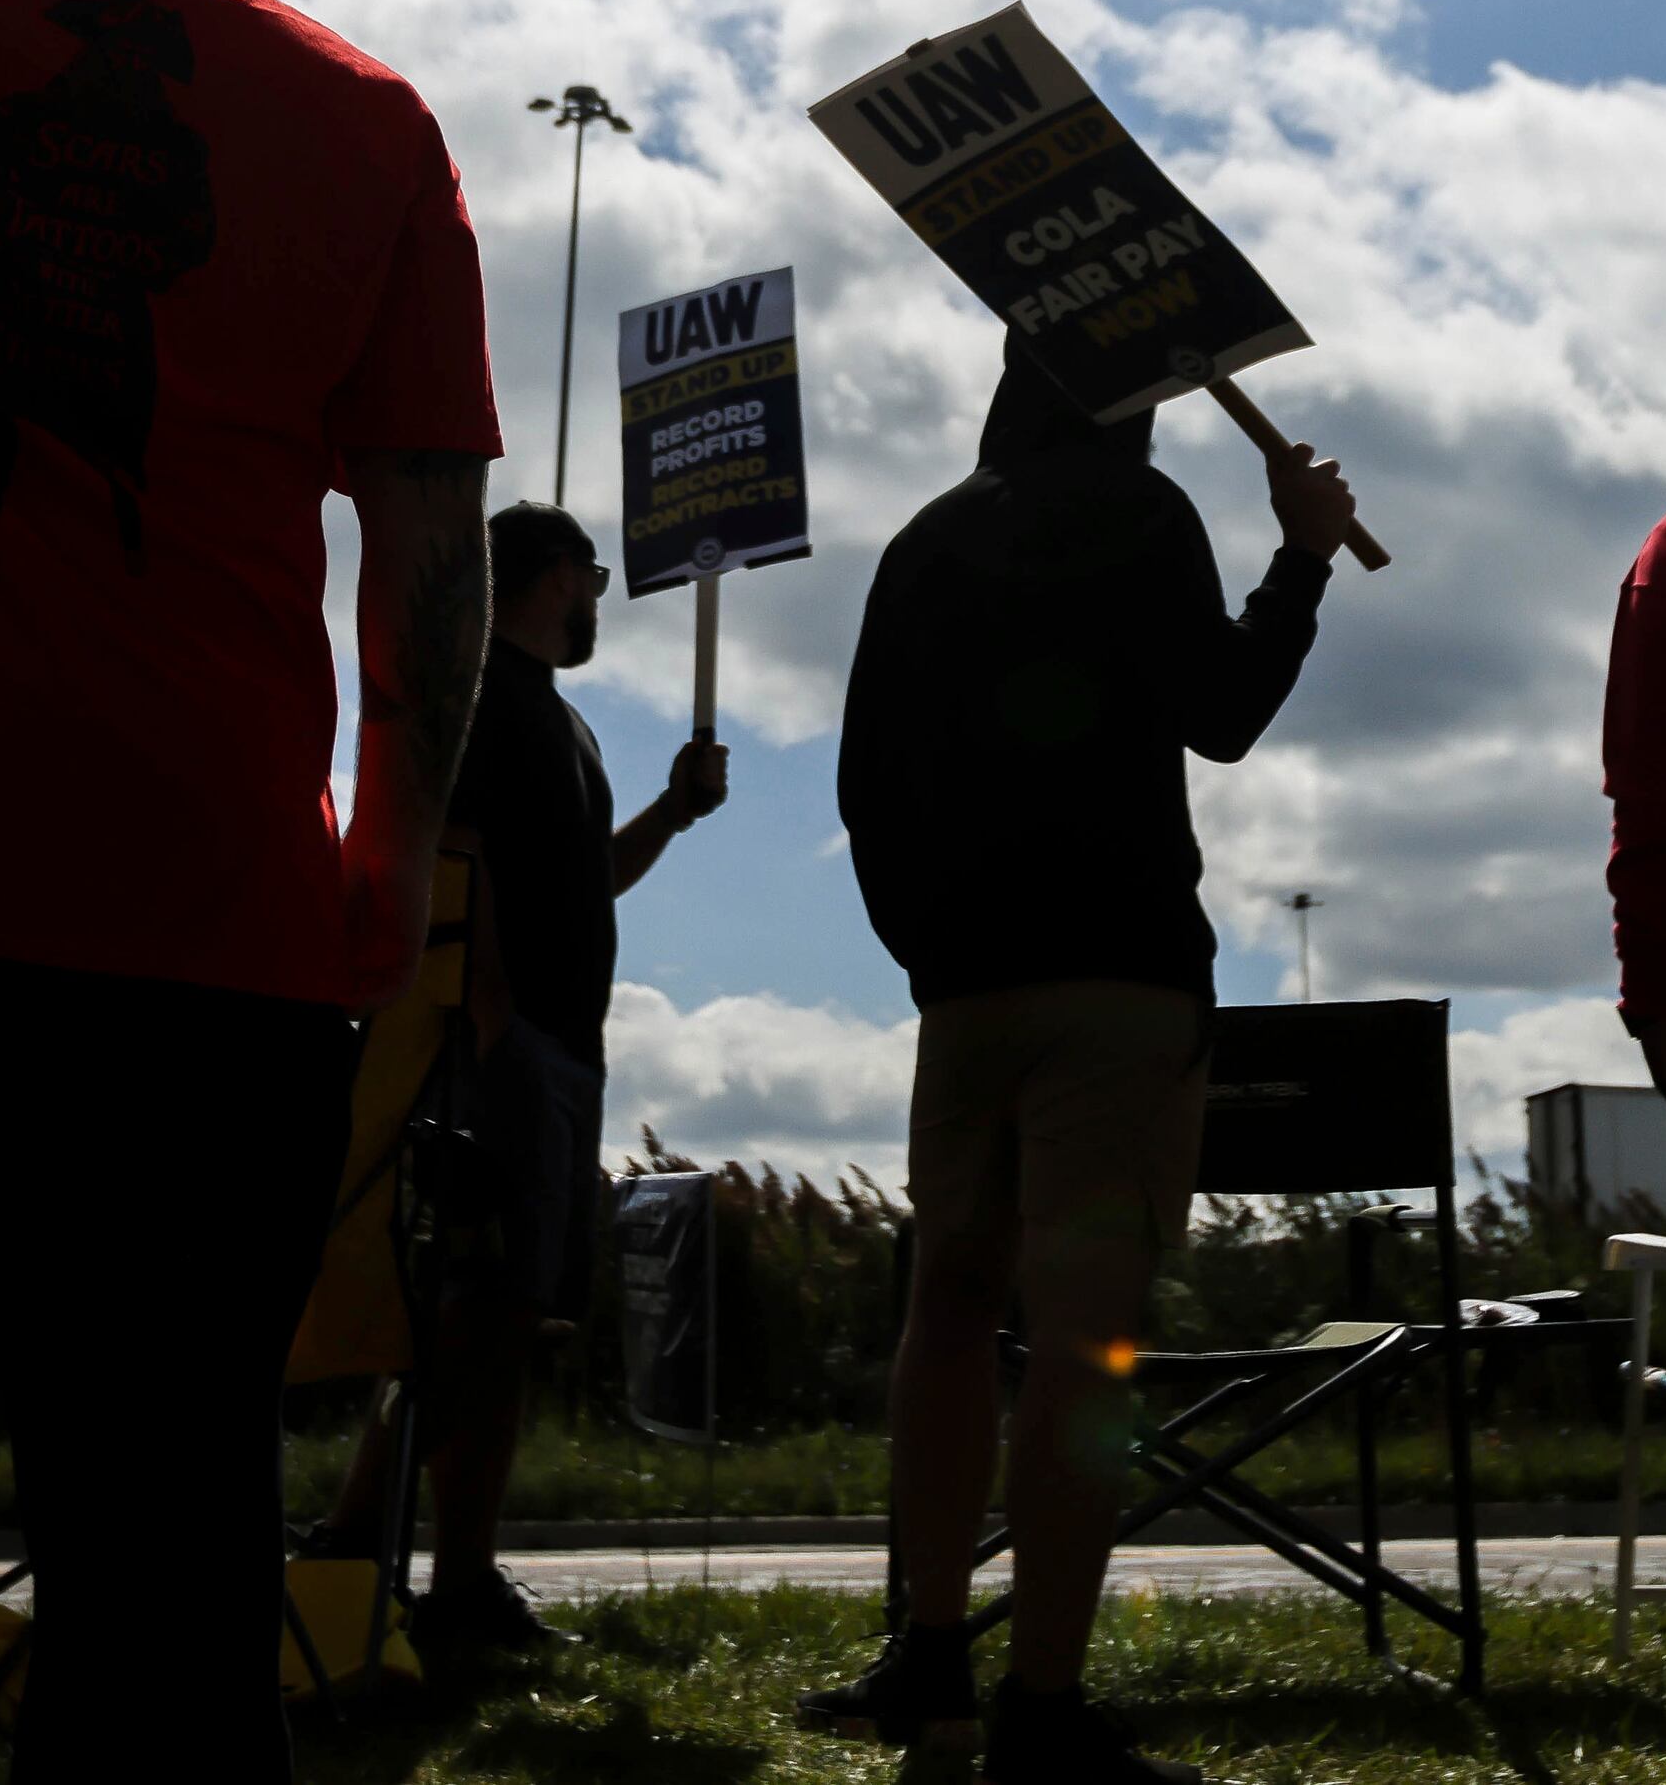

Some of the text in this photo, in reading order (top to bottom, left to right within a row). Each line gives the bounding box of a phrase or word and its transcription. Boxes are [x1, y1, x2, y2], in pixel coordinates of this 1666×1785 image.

[855, 33, 1042, 167] UAW
[920, 114, 1110, 233] STAND UP
[1004, 186, 1137, 266] COLA
[1005, 213, 1208, 335] FAIR PAY
[1078, 270, 1200, 351] NOW
[645, 280, 764, 365] UAW
[632, 352, 785, 415] STAND UP
[651, 400, 765, 453] RECORD
[651, 425, 767, 478] PROFITS
[629, 477, 799, 540] CONTRACTS
[653, 456, 768, 507] RECORD
